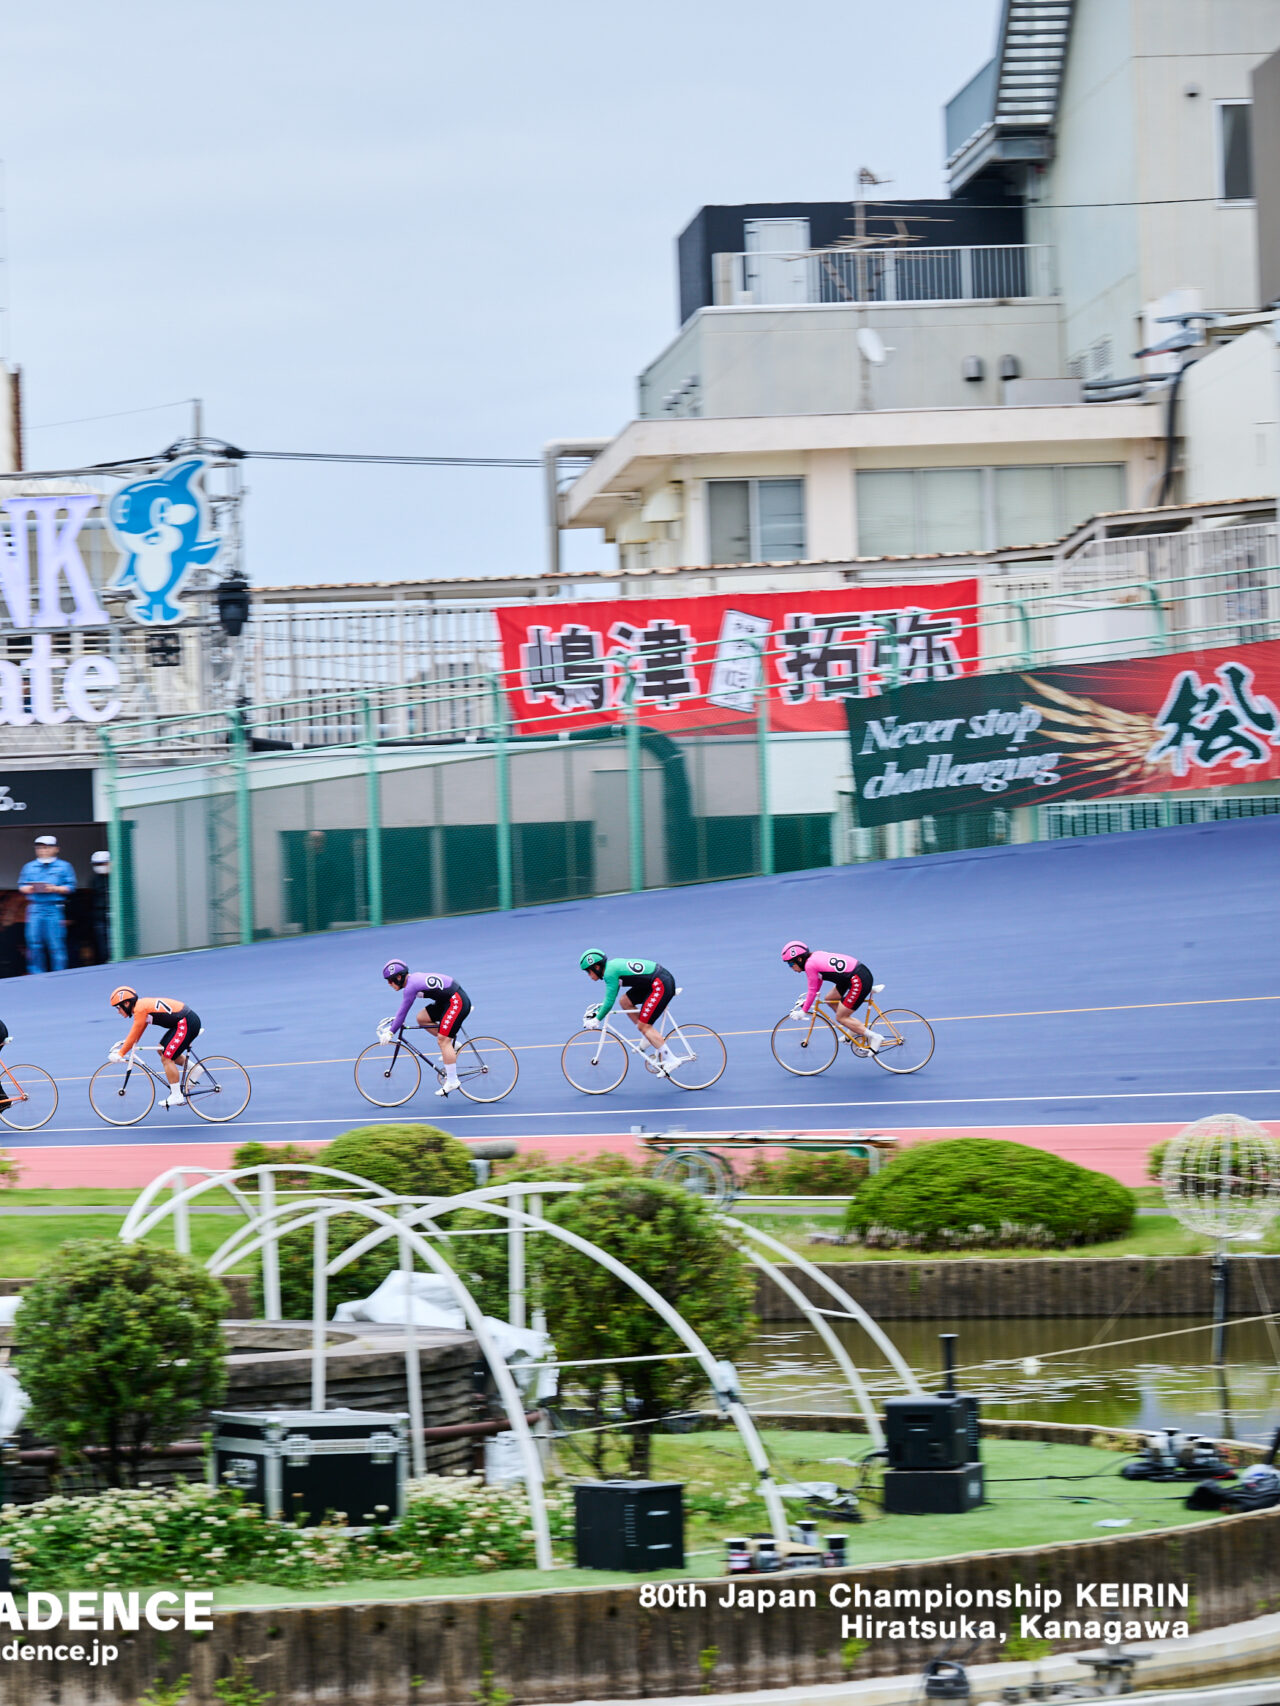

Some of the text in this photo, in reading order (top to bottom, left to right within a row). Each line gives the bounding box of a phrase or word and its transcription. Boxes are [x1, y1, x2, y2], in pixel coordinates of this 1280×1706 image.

[858, 704, 1043, 755] Never stop
[863, 748, 1064, 800] challenging
[626, 959, 646, 975] 6
[829, 957, 846, 973] 8
[425, 975, 445, 991] 9
[156, 1000, 171, 1015] 7
